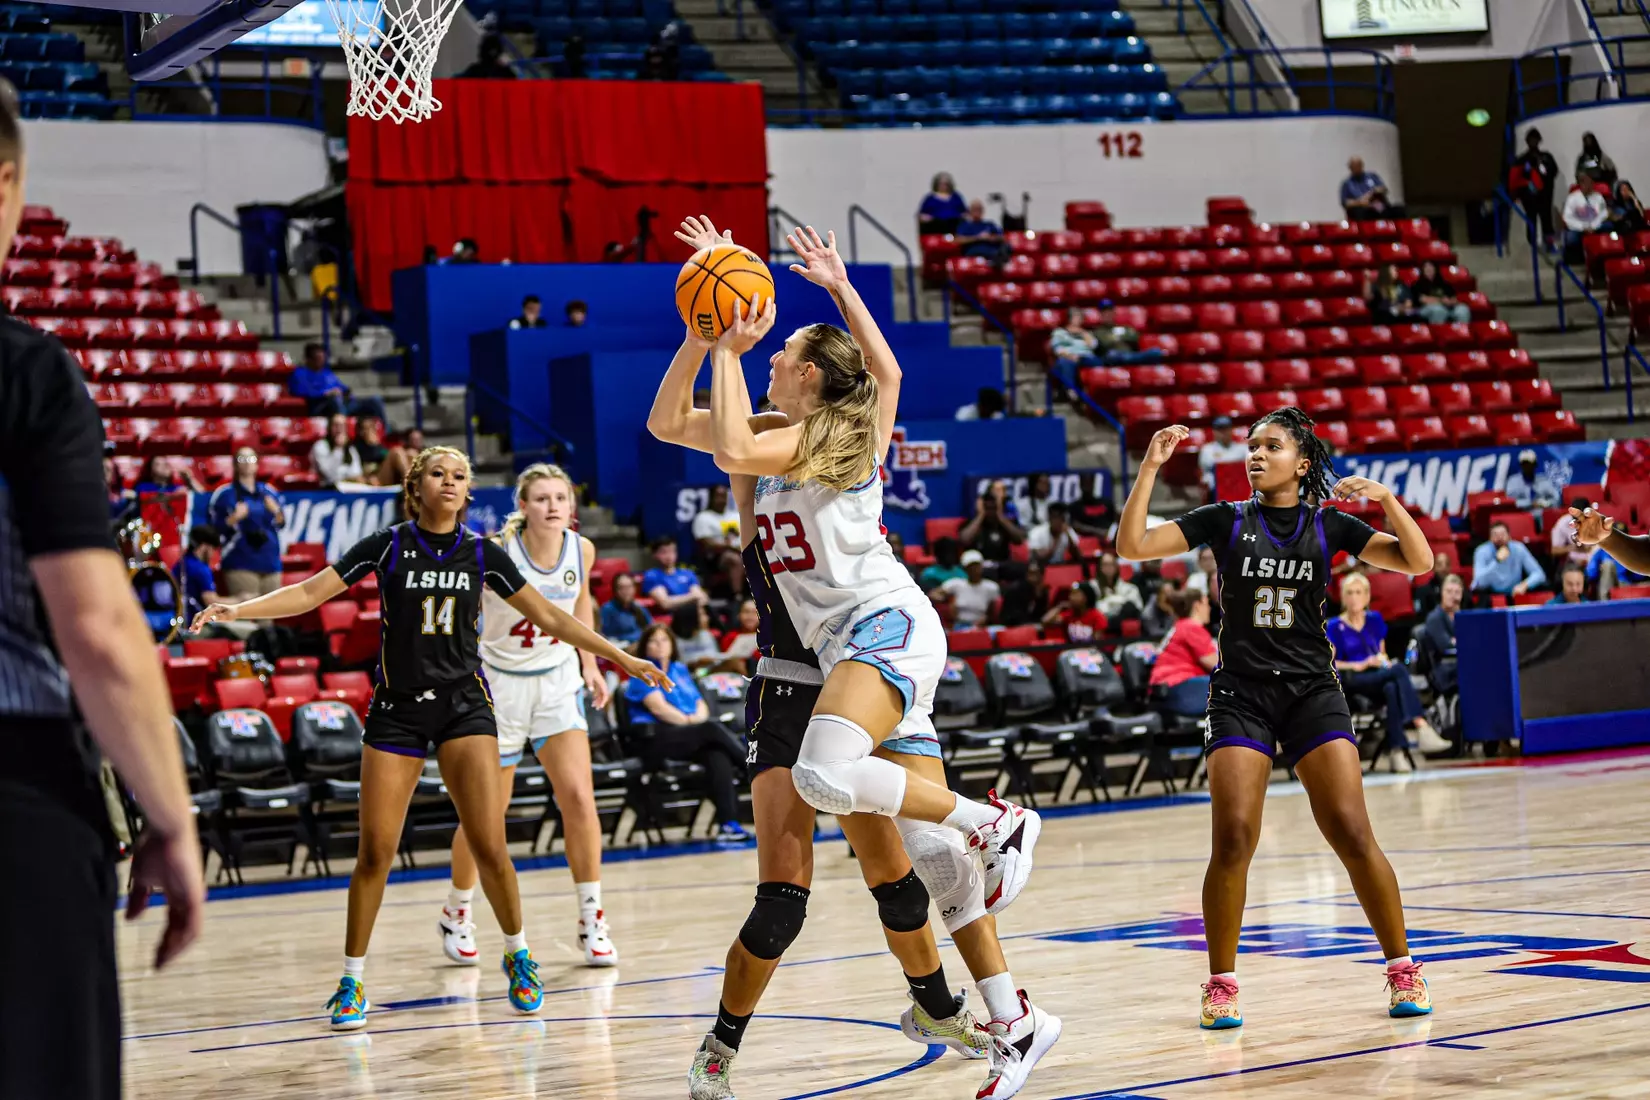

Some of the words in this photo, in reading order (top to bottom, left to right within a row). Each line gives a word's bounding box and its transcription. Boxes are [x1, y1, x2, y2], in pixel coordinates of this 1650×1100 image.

[1097, 131, 1144, 158] 112
[756, 510, 816, 575] 23
[405, 570, 471, 590] LSUA
[1241, 556, 1313, 581] LSUA
[421, 595, 456, 635] 14
[1253, 586, 1297, 628] 25
[509, 618, 560, 648] 4
